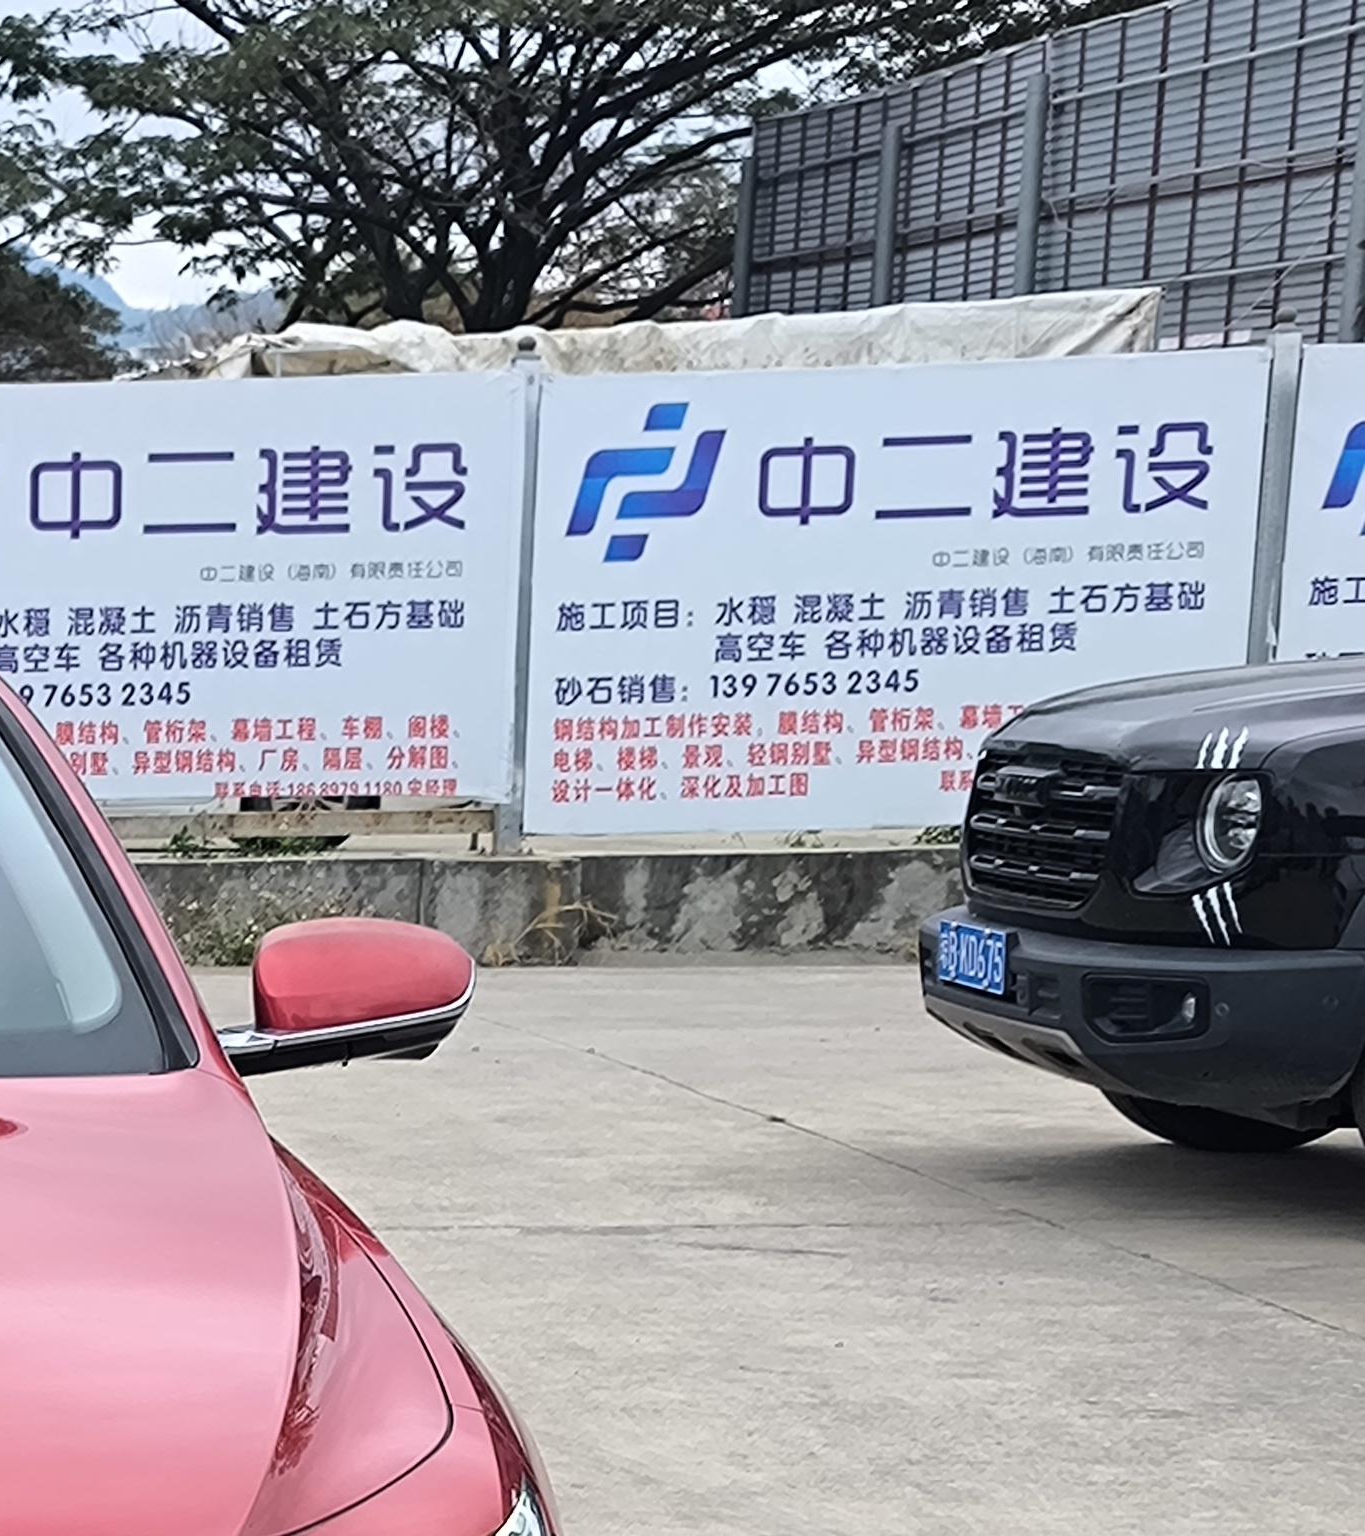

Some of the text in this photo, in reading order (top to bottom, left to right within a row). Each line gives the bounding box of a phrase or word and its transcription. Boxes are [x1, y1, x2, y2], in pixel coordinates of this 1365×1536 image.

[29, 442, 468, 540] 中二建设
[758, 421, 1214, 526] 中二建设
[67, 605, 156, 637] 混凝土
[173, 602, 295, 634] 沥青销售
[312, 598, 465, 632] 土石方基础
[793, 592, 885, 624] 混凝土
[904, 587, 1029, 621] 沥青销售
[1047, 580, 1206, 614] 土石方基础
[98, 637, 343, 670] 各种机器设备租赁
[714, 621, 1079, 663] 高空车 各种机器设备租赁
[43, 683, 112, 708] 7653
[121, 681, 191, 707] 2345
[709, 673, 757, 699] 139
[766, 671, 837, 697] 7653
[846, 667, 919, 695] 2345
